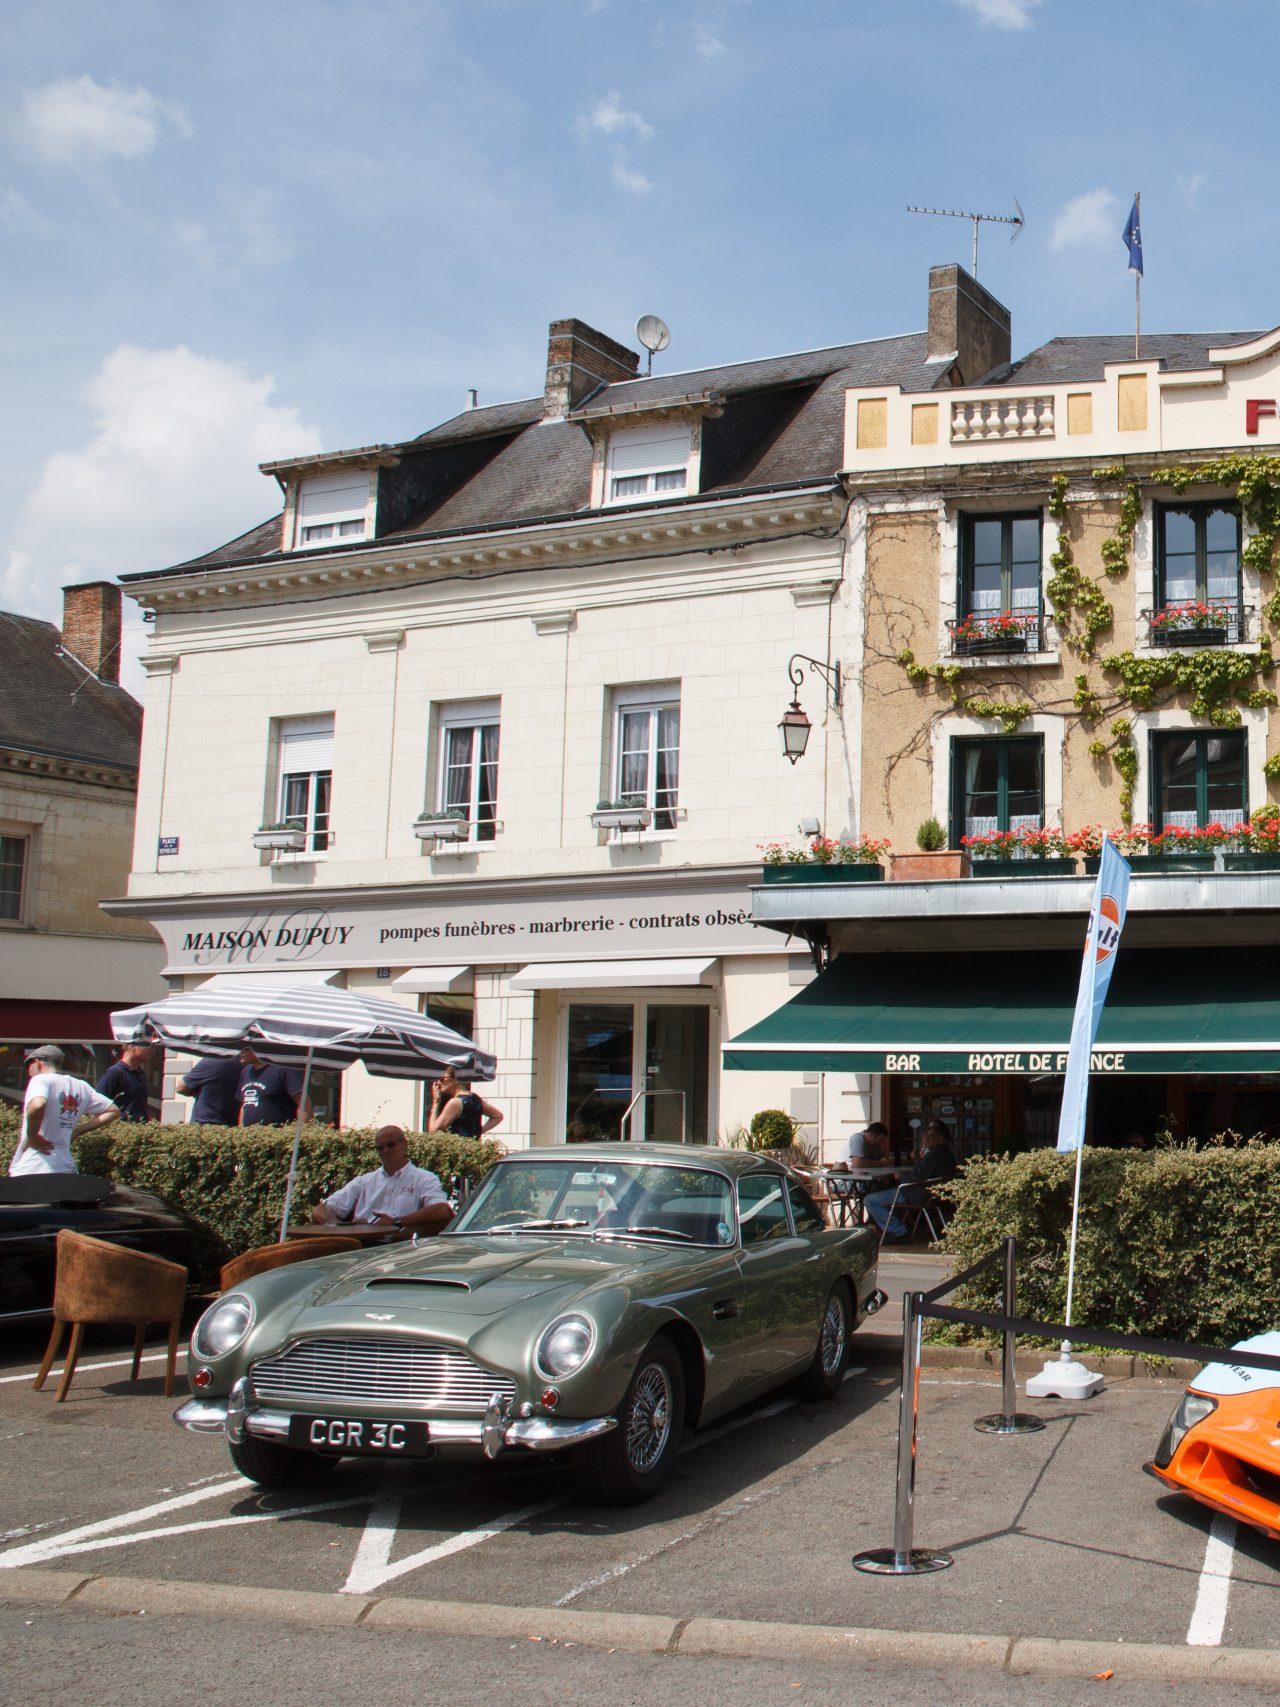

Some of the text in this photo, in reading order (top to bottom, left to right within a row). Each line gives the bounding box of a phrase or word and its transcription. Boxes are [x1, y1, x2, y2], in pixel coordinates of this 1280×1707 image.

[182, 930, 271, 950] MAISON
[274, 926, 355, 947] DUPUY
[380, 923, 440, 943] pompes
[445, 919, 516, 938] funèbres
[529, 914, 614, 934] marbrerie
[629, 911, 700, 929] contrats
[378, 967, 389, 977] 18
[885, 1054, 920, 1071] BAR
[968, 1054, 1125, 1071] HOTEL DE FNCE
[310, 1419, 406, 1449] CGR 3C
